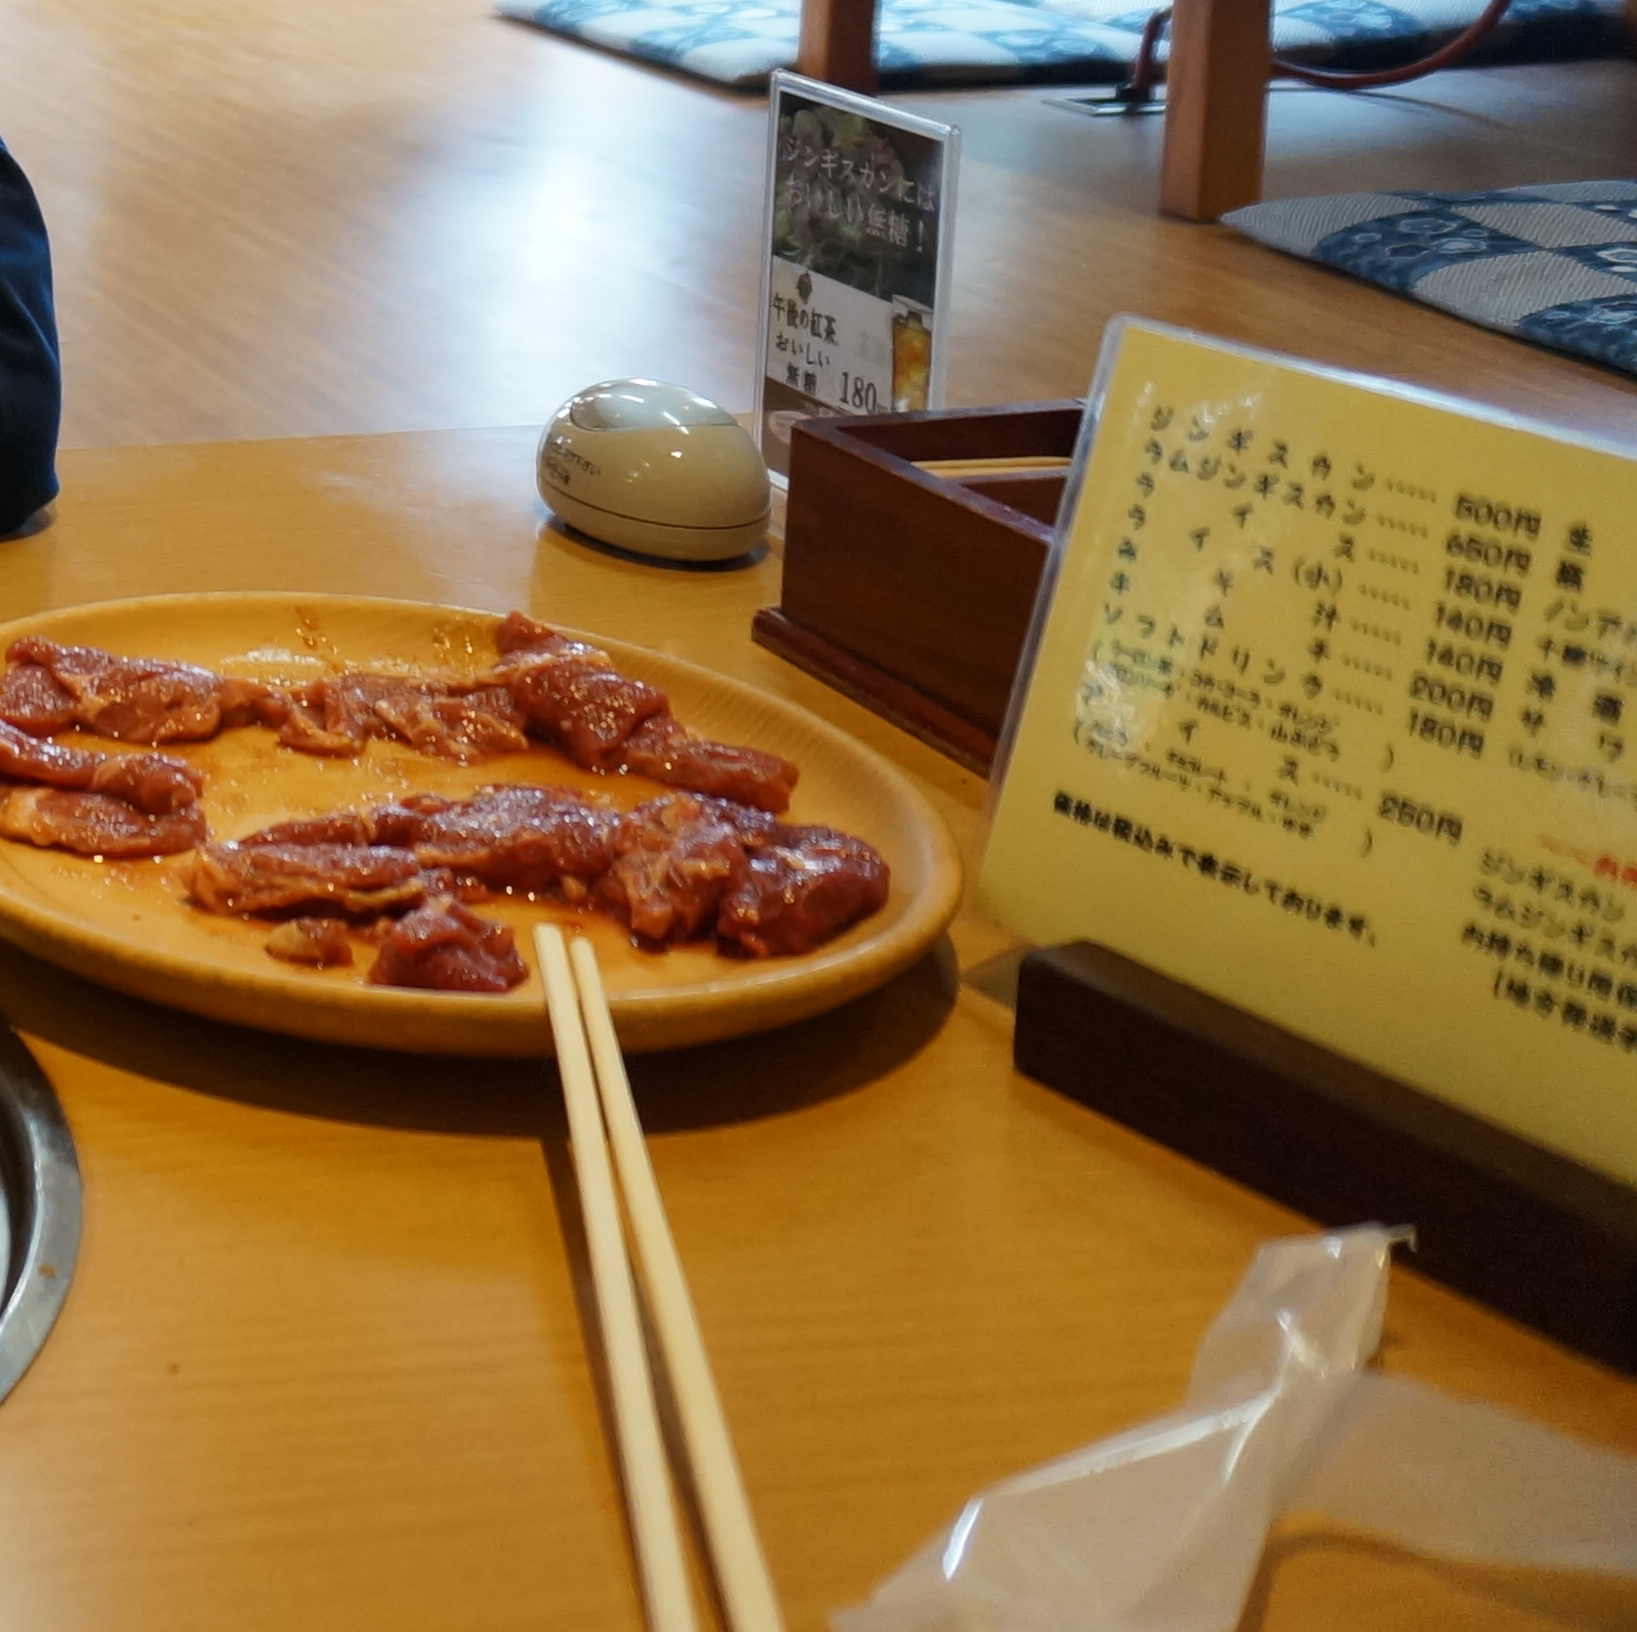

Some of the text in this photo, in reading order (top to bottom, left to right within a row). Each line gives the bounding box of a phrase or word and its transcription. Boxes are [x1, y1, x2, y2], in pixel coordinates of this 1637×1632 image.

[781, 137, 936, 212] ジンギスカンには
[772, 292, 838, 346] 午後の紅茶
[776, 332, 830, 367] おいしい
[785, 361, 817, 397] 無糖
[1145, 438, 1366, 525] ラムジンギスカン
[1150, 406, 1541, 540] ジンギスカン 500円
[1104, 602, 1322, 700] ソフトドリンク
[1379, 791, 1463, 845] 250円
